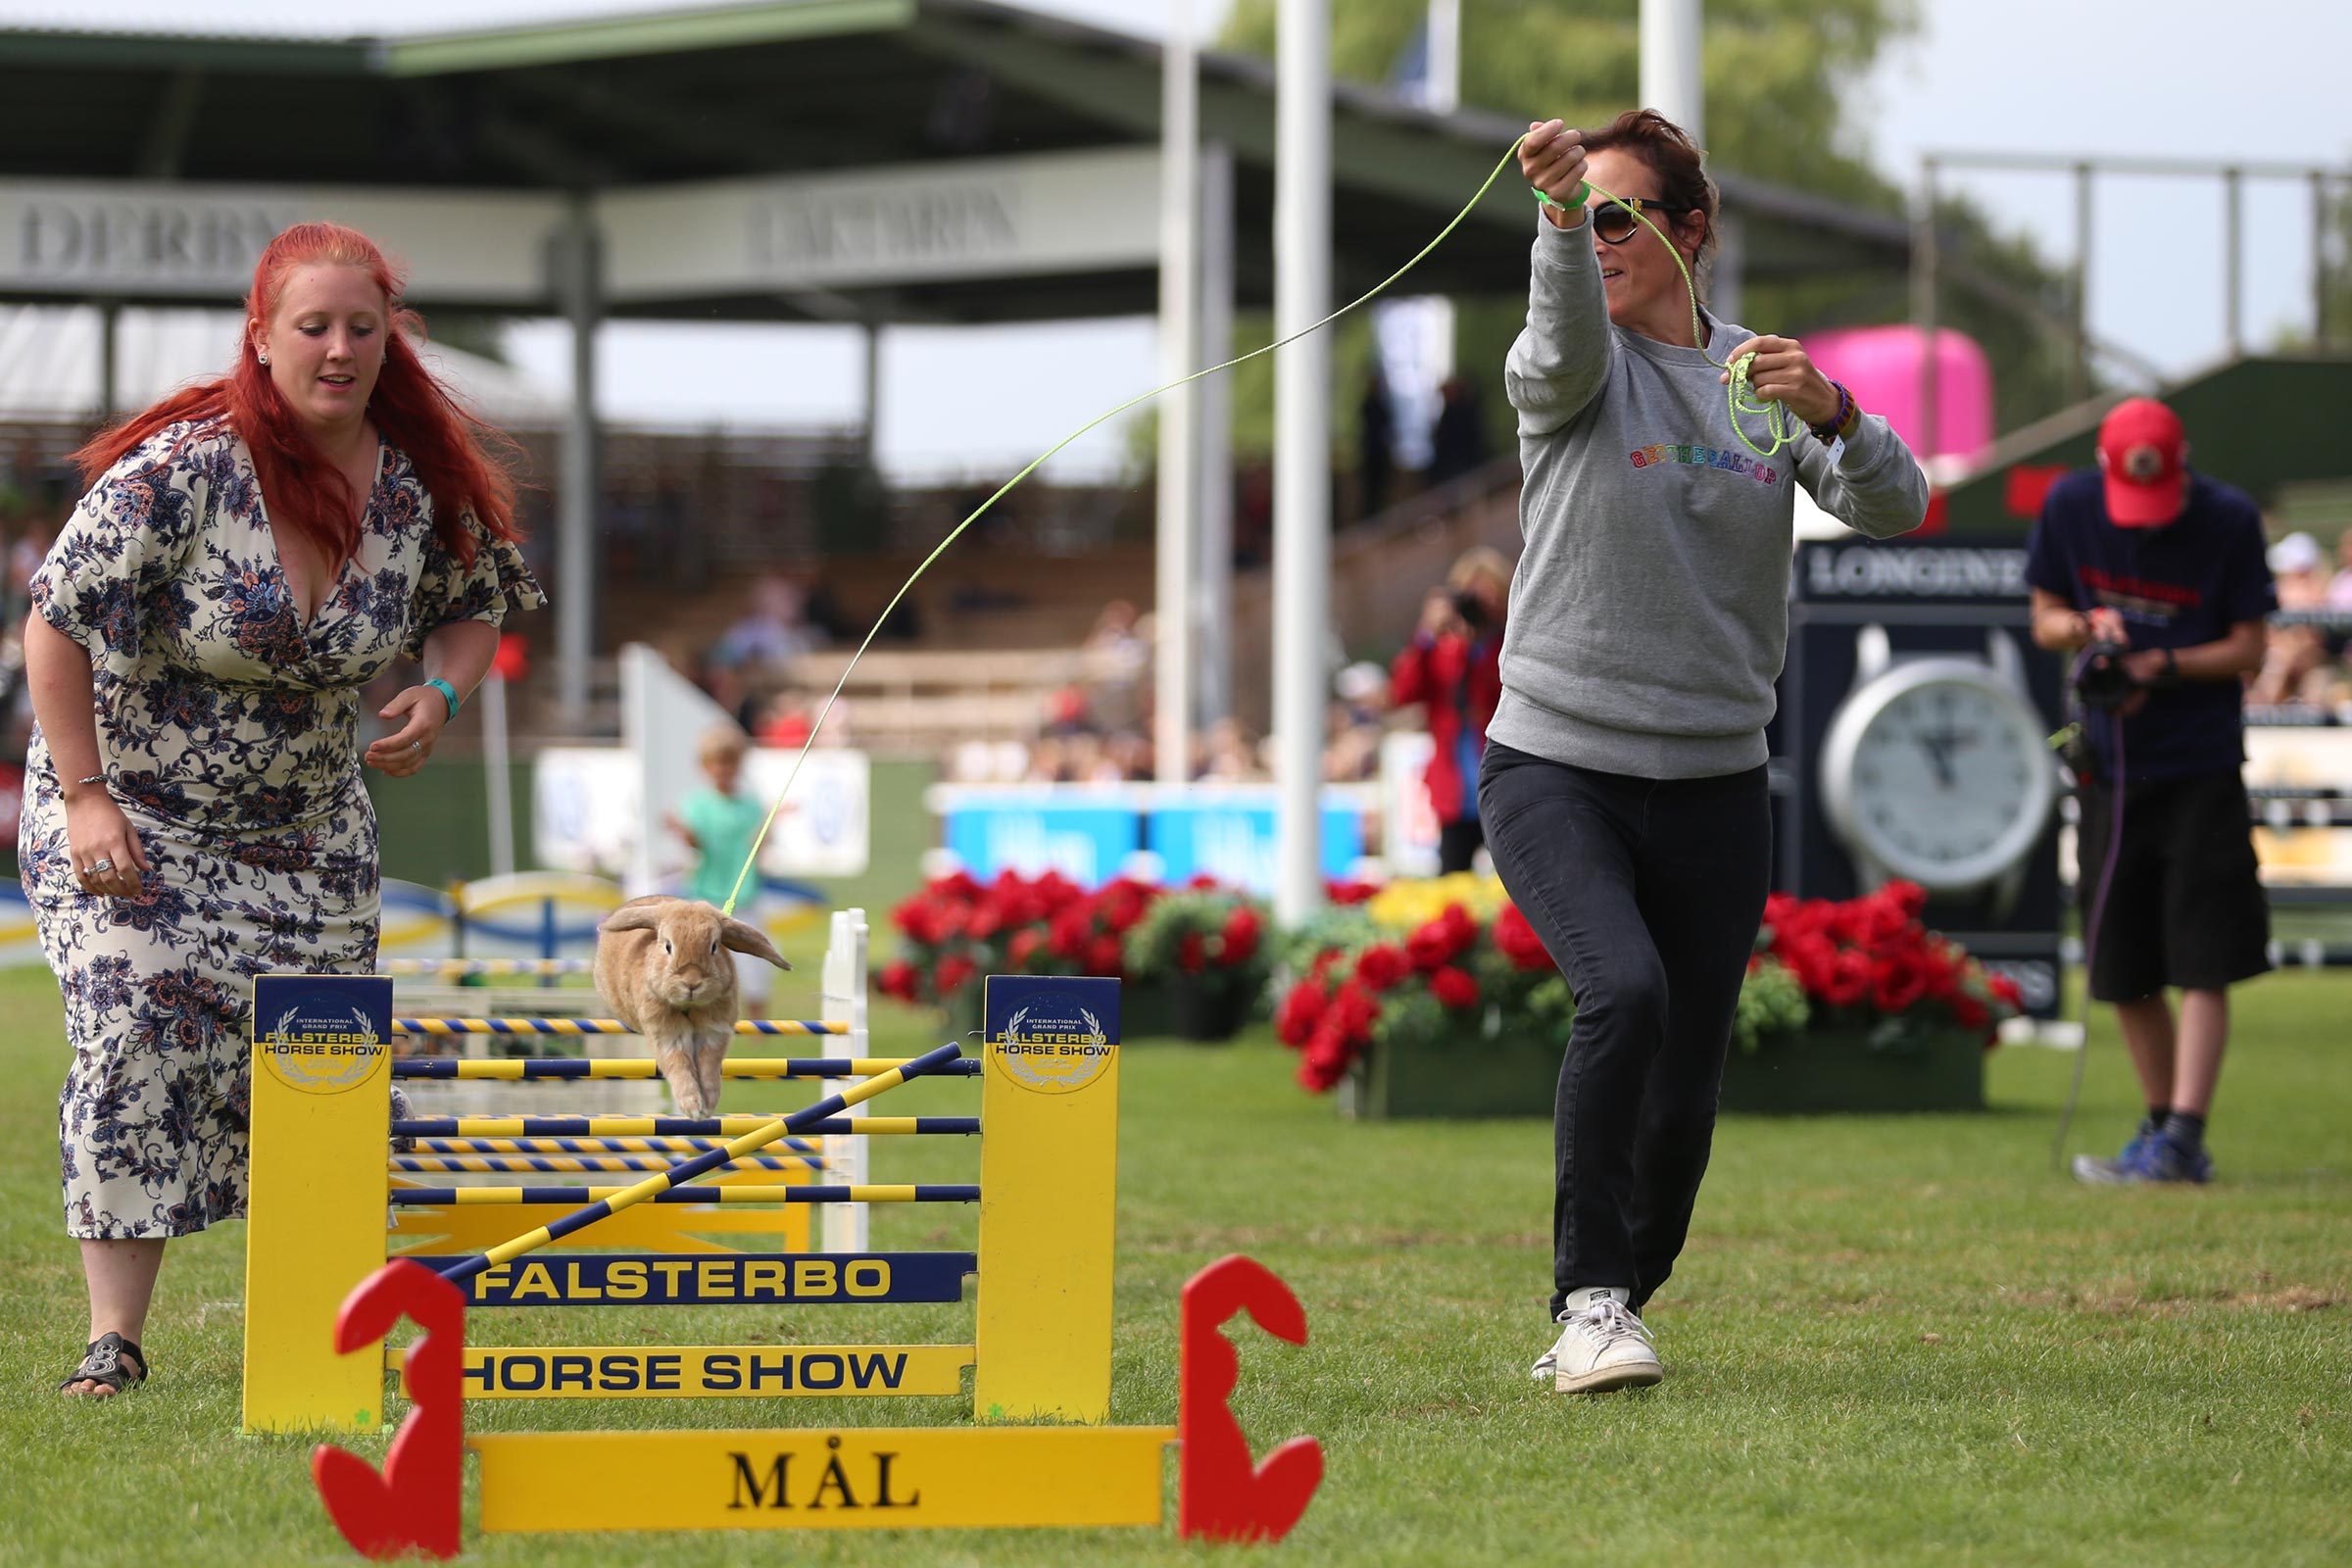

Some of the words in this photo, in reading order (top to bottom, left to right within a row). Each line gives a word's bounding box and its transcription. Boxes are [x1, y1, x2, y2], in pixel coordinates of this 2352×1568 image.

[1630, 444, 1665, 469] GET
[1666, 445, 1705, 465] THE
[1708, 450, 1777, 484] GALLOP
[1809, 547, 2029, 595] LONGINE
[265, 1032, 379, 1044] FALSTERBO
[265, 1045, 324, 1055] HORSE
[330, 1046, 383, 1055] SHOW
[996, 1032, 1107, 1044] FALSTERBO
[996, 1045, 1054, 1055] HORSE
[1059, 1046, 1111, 1056] SHOW
[474, 1259, 891, 1299] FALSTERBO
[463, 1354, 682, 1391] HORSE
[702, 1352, 908, 1390] SHOW
[726, 1435, 920, 1509] MÅL
